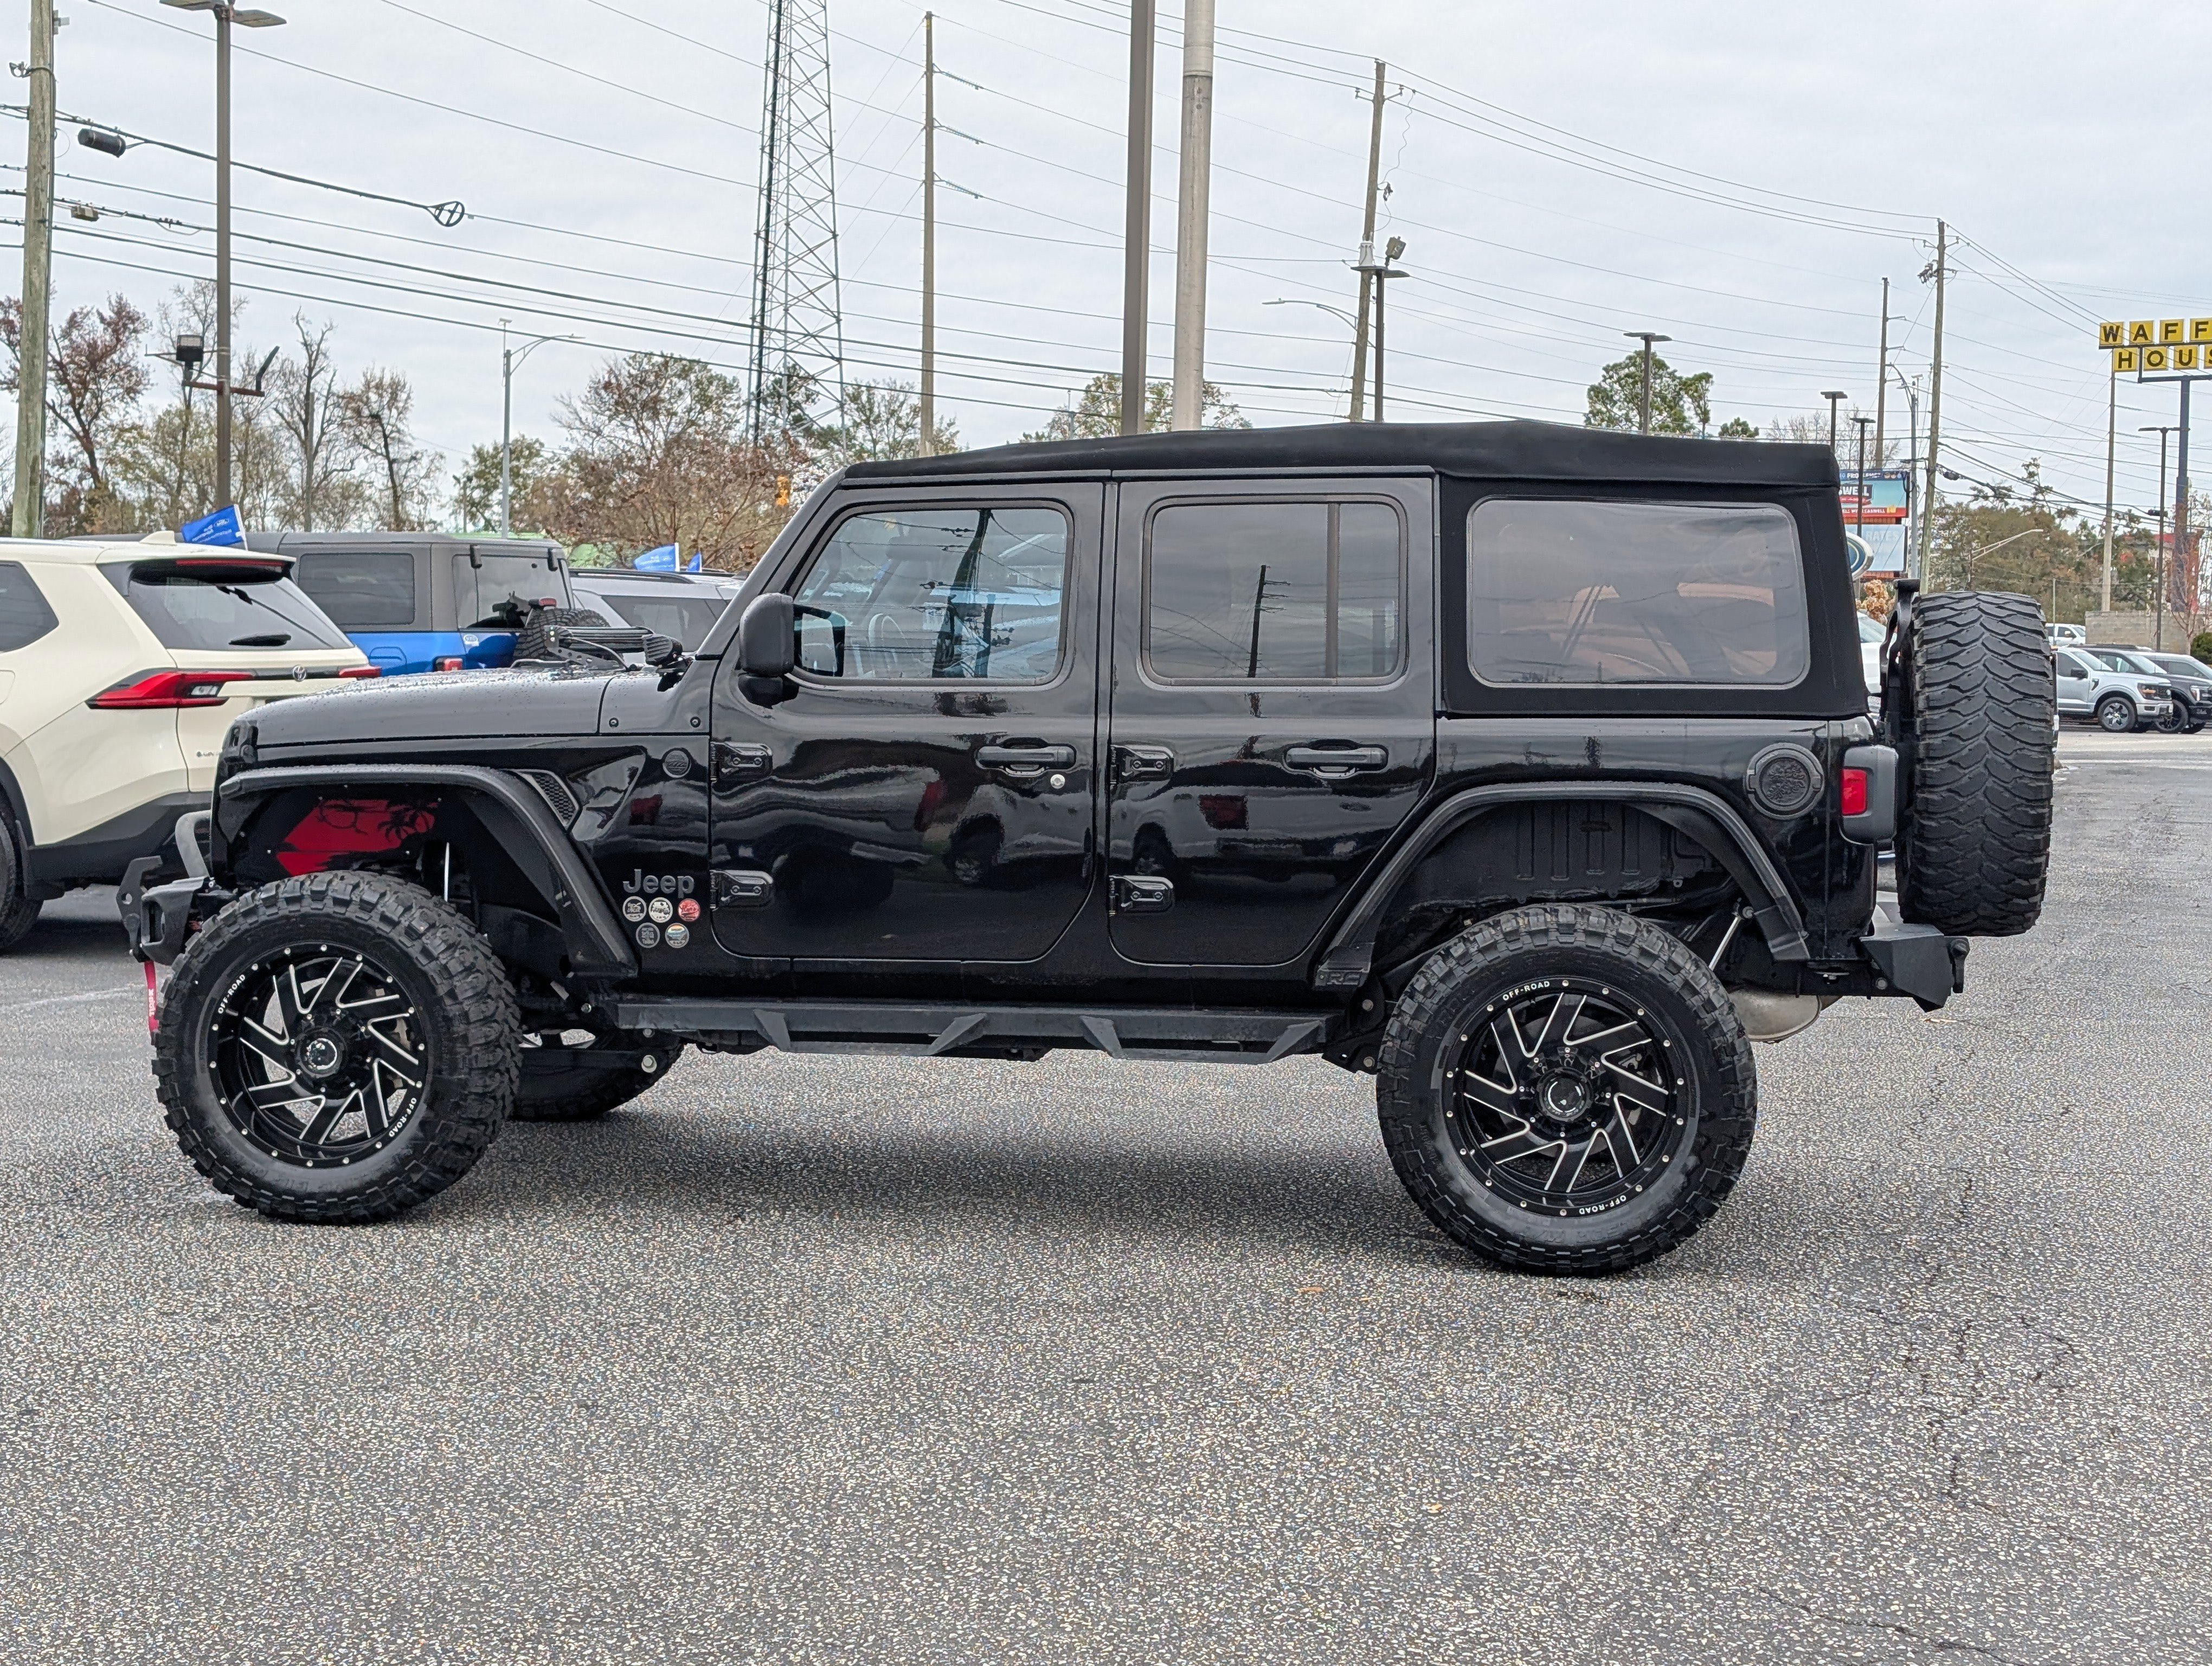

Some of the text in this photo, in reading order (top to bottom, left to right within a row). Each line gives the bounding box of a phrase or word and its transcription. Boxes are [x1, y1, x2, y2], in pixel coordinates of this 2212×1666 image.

[2103, 321, 2209, 342] WAFF
[2118, 348, 2212, 369] HOU
[623, 869, 695, 899] Jeep
[218, 974, 246, 1014] OFF-ROAD
[1502, 981, 1550, 1001] OFF-ROAD
[389, 1098, 417, 1137] OFF-ROAD
[1579, 1195, 1626, 1215] OFF-ROAD
